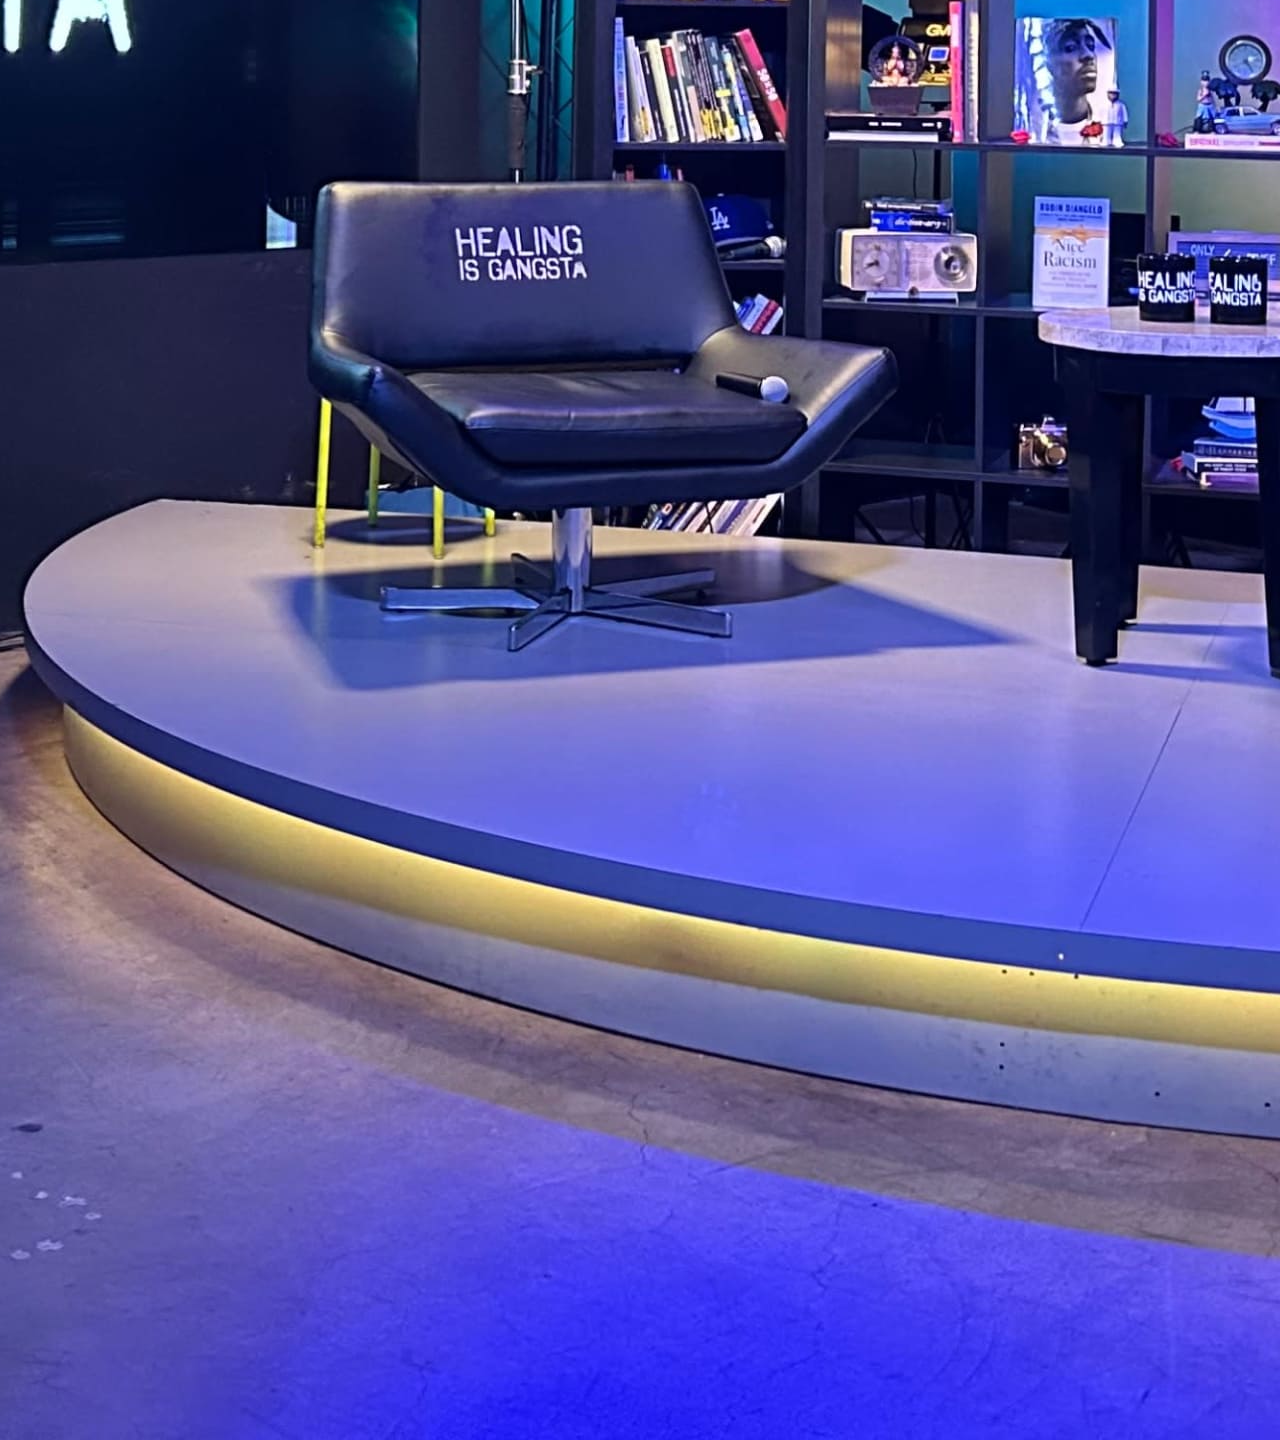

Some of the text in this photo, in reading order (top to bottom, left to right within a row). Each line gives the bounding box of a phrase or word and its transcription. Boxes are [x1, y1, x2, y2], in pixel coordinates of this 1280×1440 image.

[709, 206, 731, 231] LA
[455, 225, 583, 257] HEALING
[459, 257, 587, 281] IS GANGSTA
[1043, 250, 1097, 269] Racism
